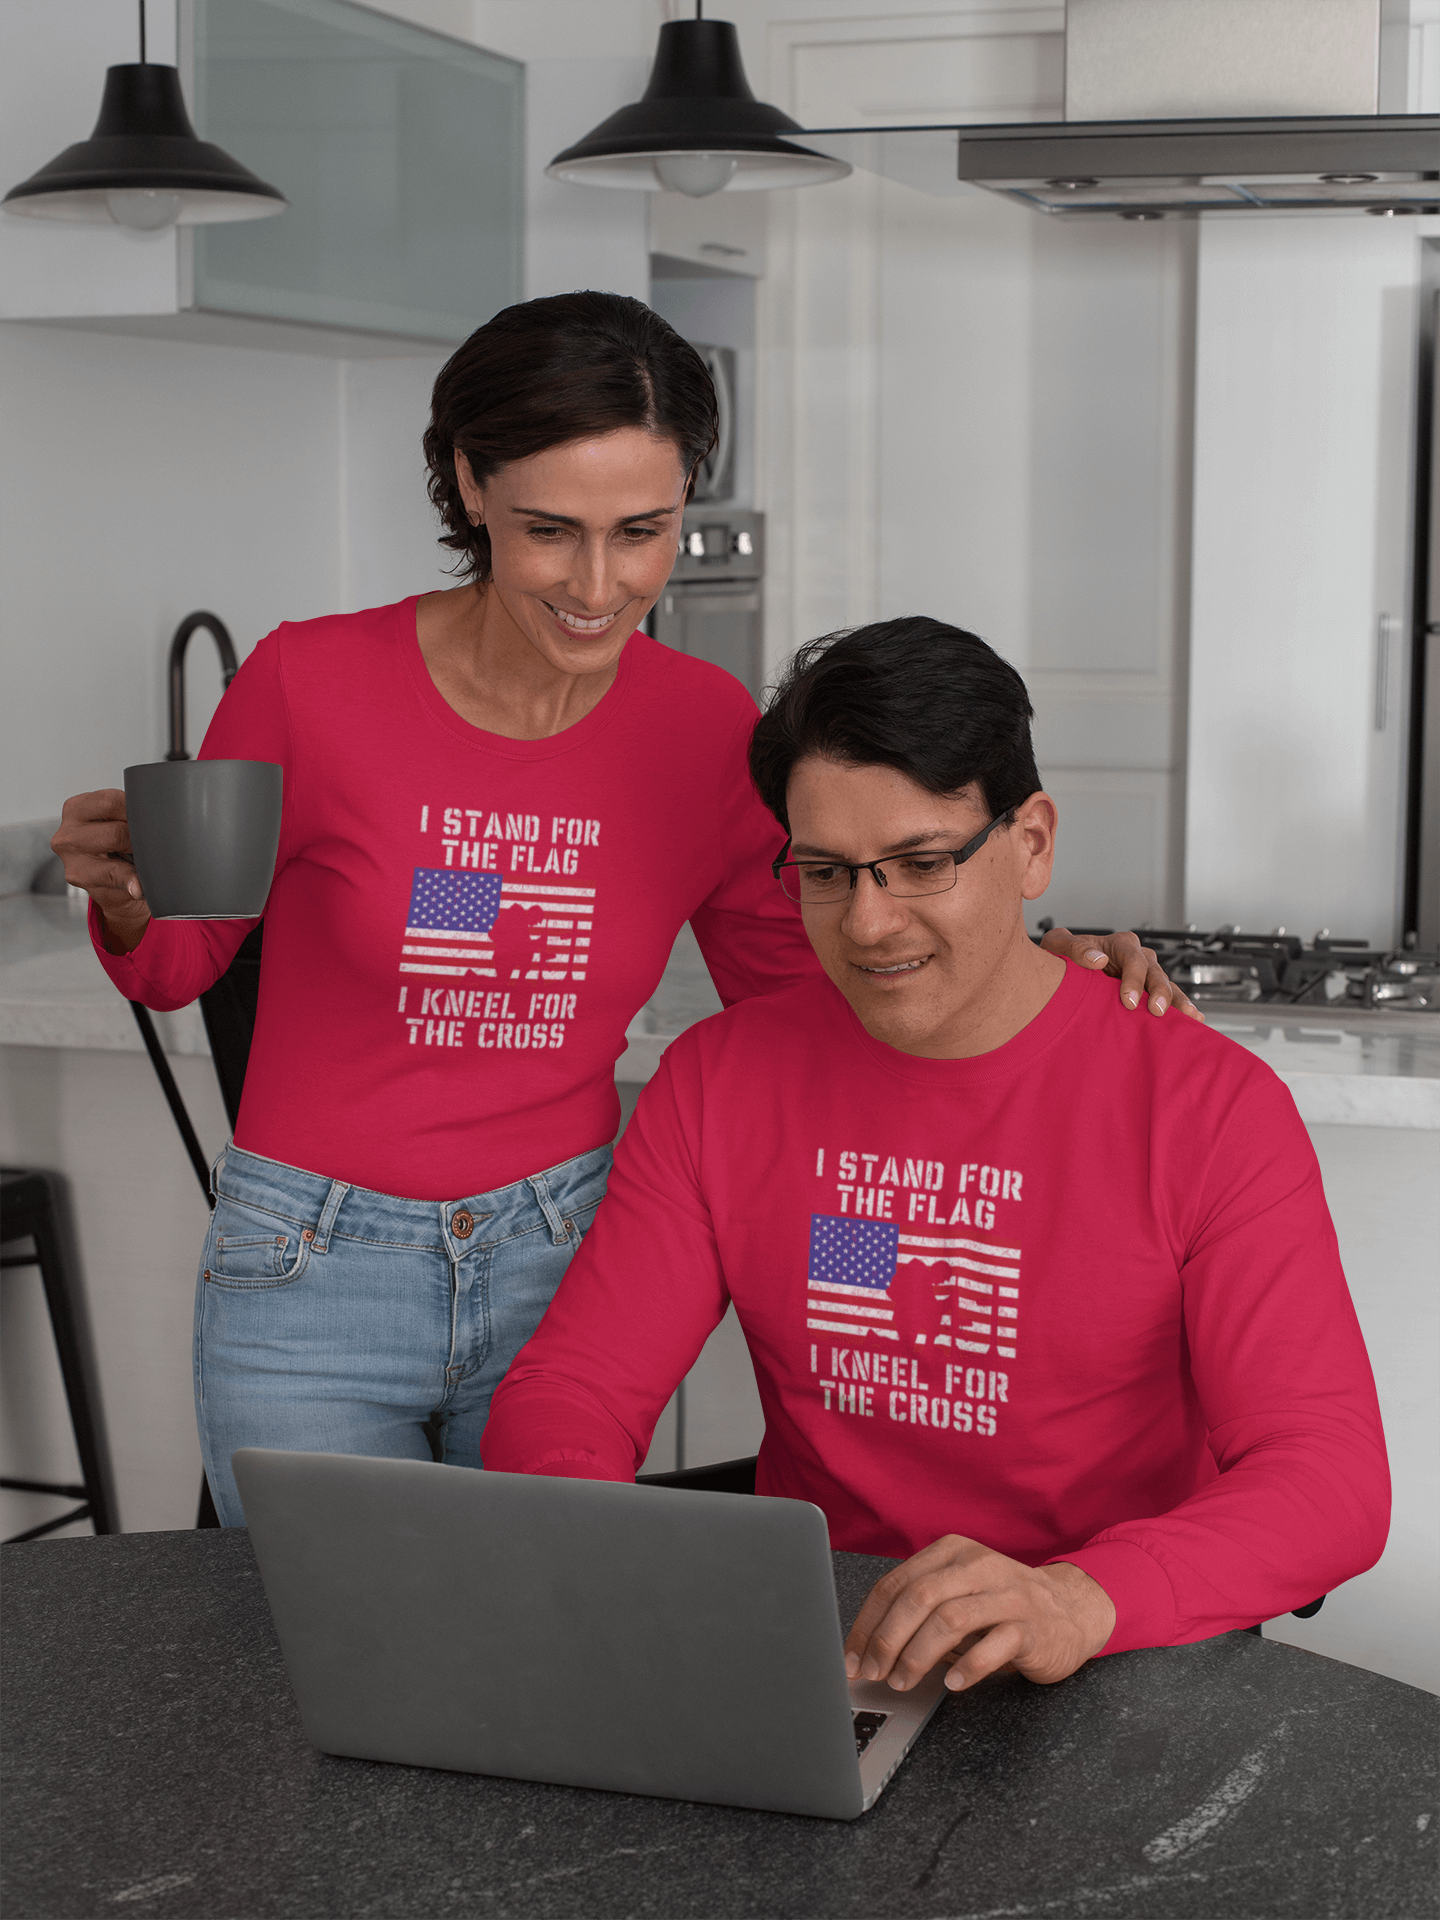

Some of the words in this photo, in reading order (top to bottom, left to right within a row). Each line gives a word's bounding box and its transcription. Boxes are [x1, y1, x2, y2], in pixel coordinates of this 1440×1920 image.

[420, 805, 429, 833] I
[443, 807, 540, 842] STAND
[551, 816, 600, 846] FOR
[442, 839, 498, 869] THE
[510, 844, 579, 875] FLAG
[398, 986, 408, 1013] I
[420, 987, 516, 1019] KNEEL
[528, 993, 577, 1019] FOR
[406, 1018, 465, 1047] THE
[477, 1022, 565, 1049] CROSS
[816, 1148, 824, 1177] I
[838, 1151, 944, 1191] STAND
[959, 1163, 1023, 1202] FOR
[837, 1184, 894, 1218] THE
[908, 1193, 996, 1230] FLAG
[810, 1344, 817, 1373] I
[831, 1347, 929, 1391] KNEEL
[945, 1363, 1009, 1403] FOR
[819, 1379, 874, 1417] THE
[889, 1390, 997, 1437] CROSS
